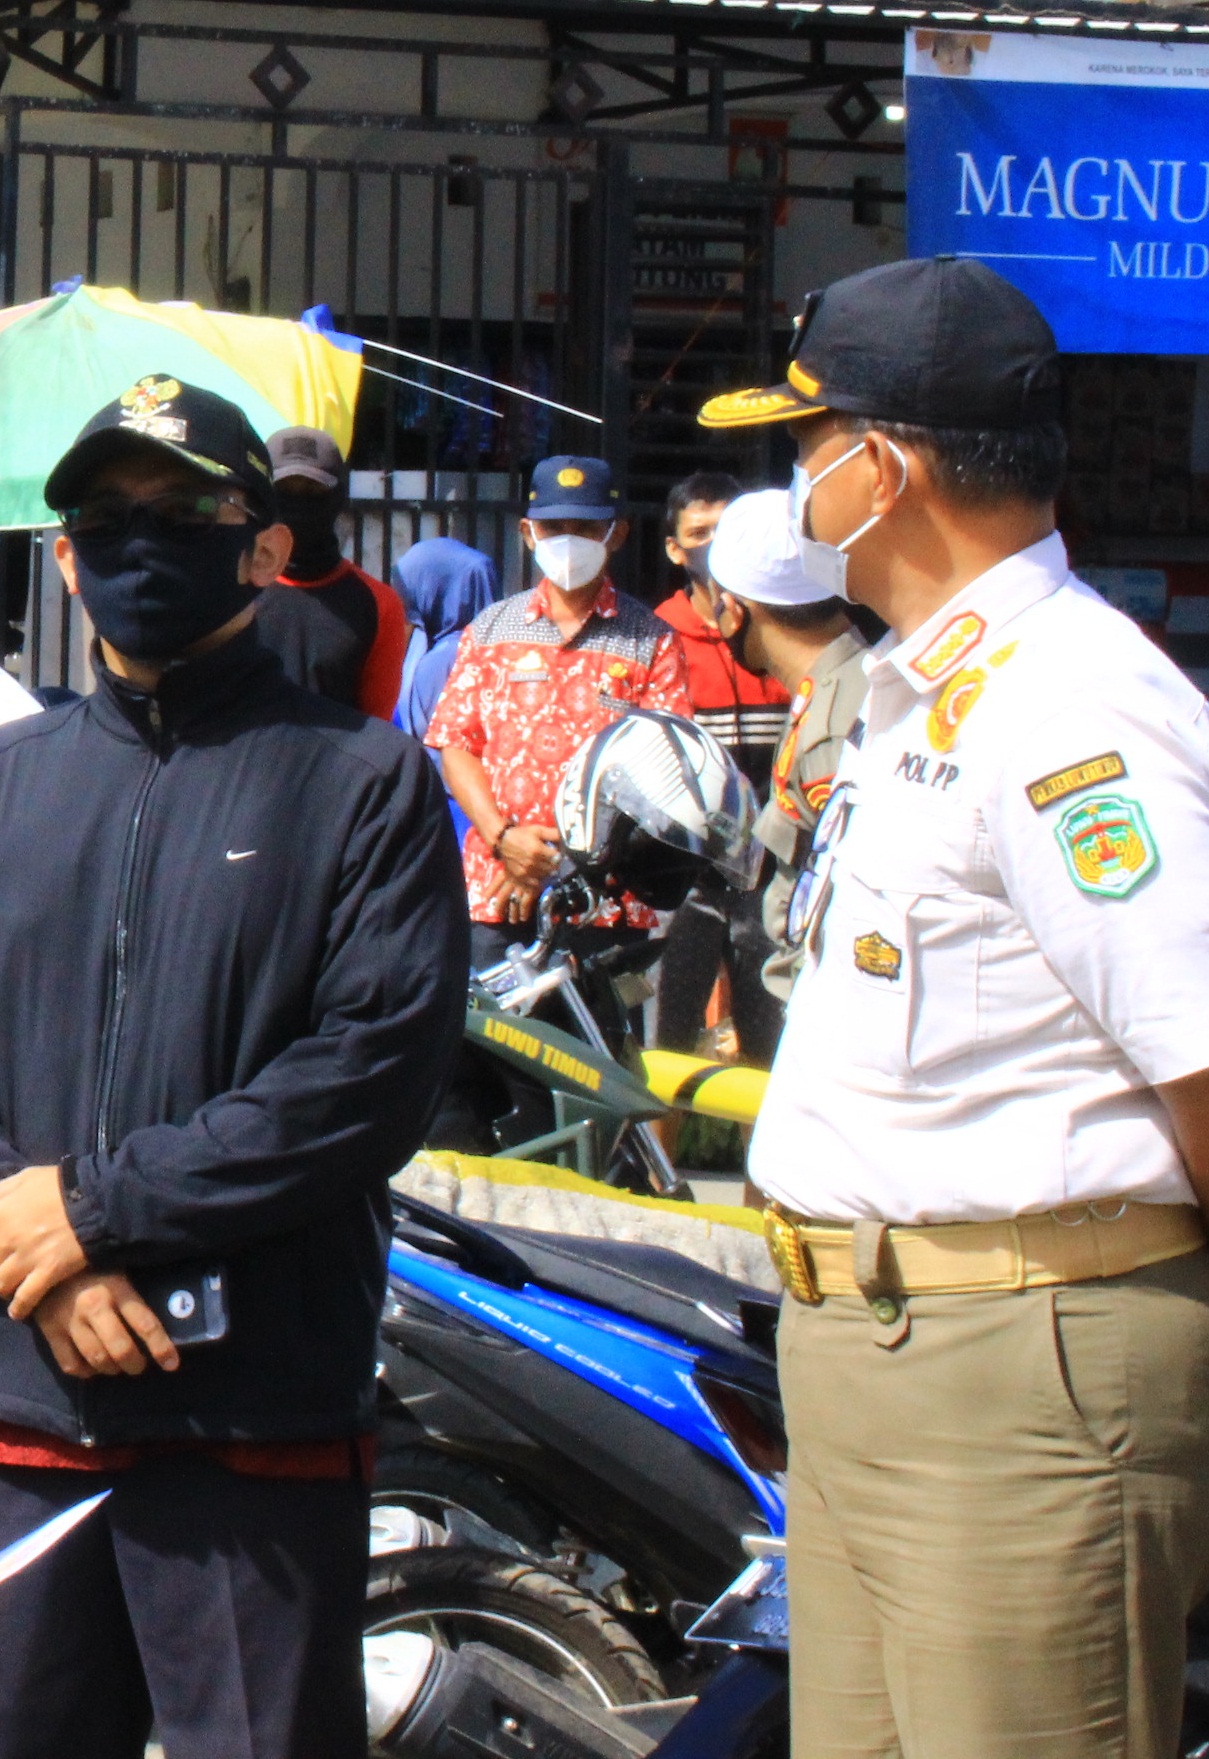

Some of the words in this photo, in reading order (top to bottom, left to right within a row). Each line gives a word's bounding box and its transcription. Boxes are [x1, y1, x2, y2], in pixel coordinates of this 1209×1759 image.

[1108, 241, 1209, 279] MILD
[930, 761, 960, 791] PP
[484, 1017, 542, 1059] LUWU
[542, 1043, 603, 1092] TIMUR
[458, 1291, 552, 1343] LIQUID
[554, 1343, 677, 1409] COOLED
